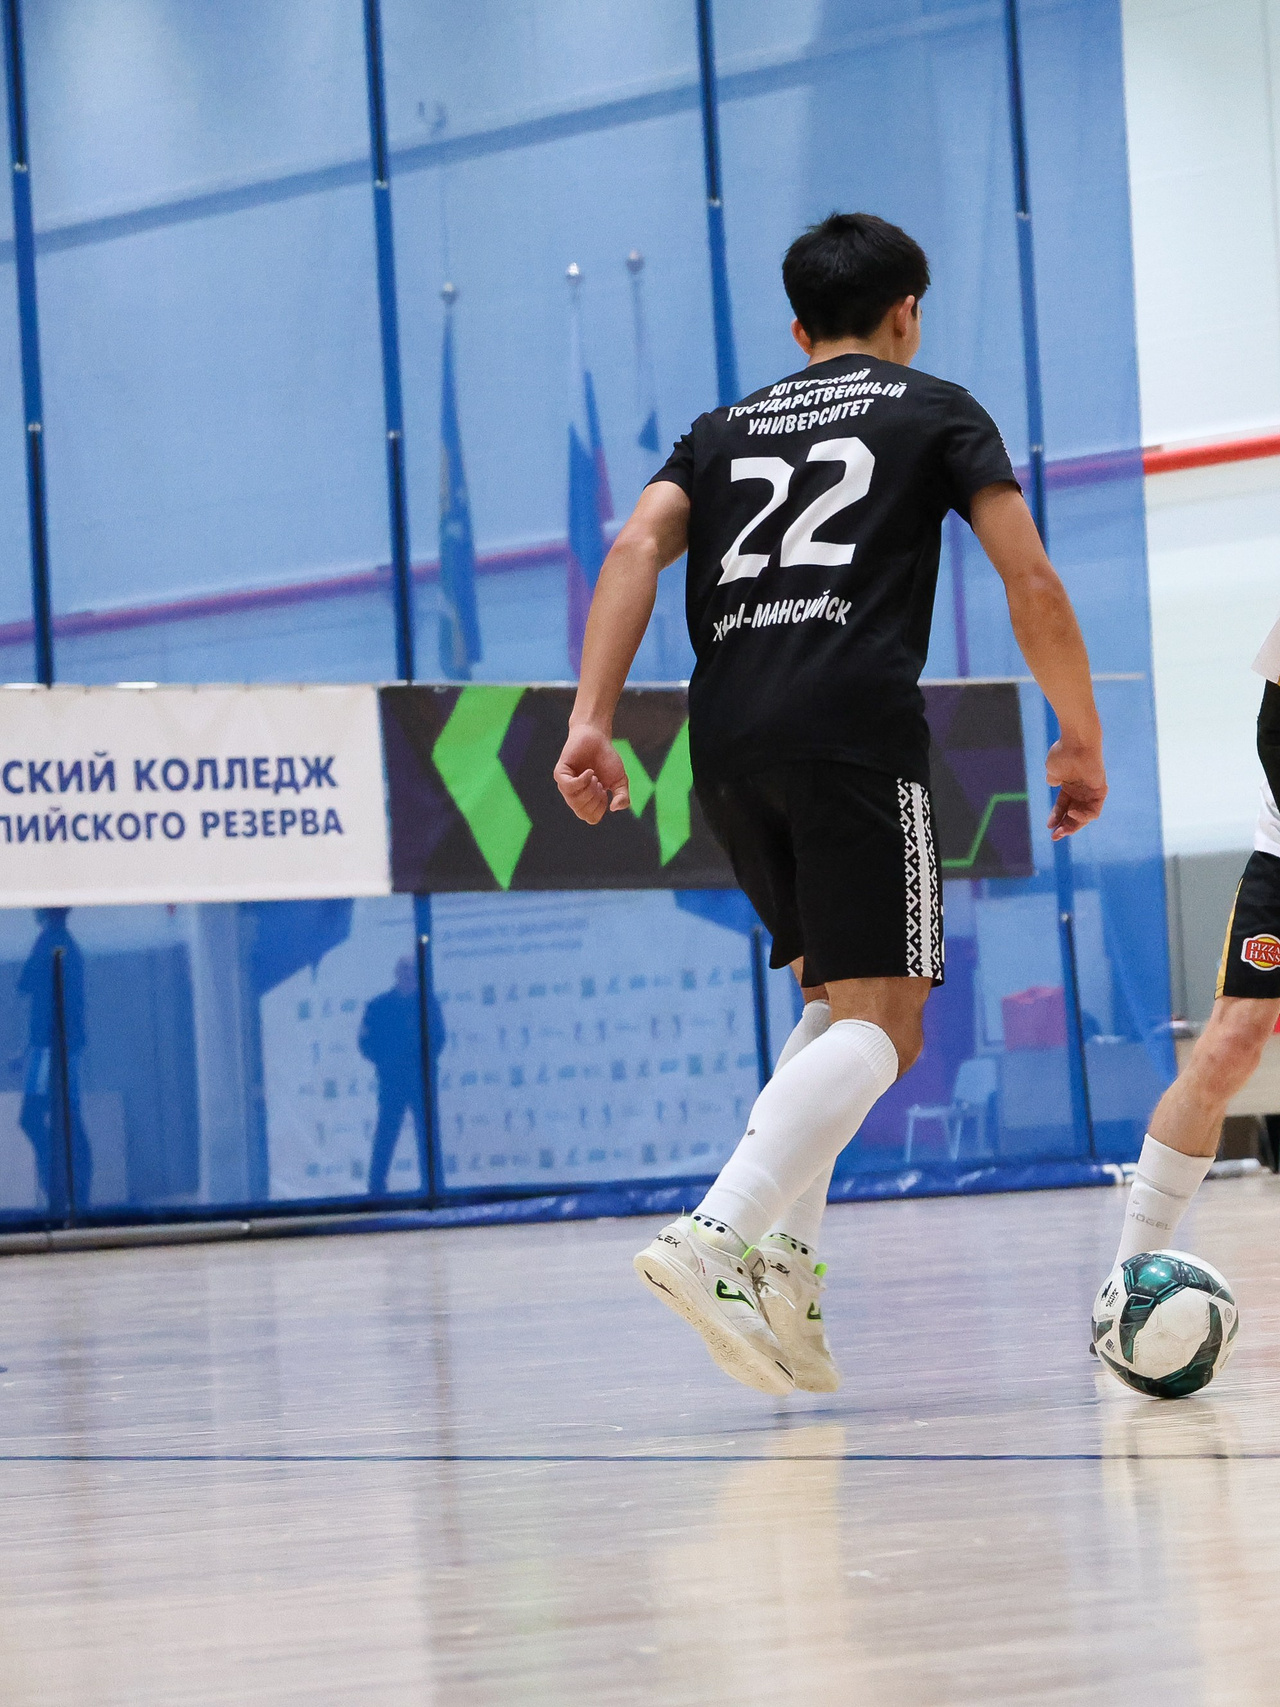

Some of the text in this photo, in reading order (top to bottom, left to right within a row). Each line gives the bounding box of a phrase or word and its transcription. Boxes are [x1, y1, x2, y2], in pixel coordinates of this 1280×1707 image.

[727, 382, 907, 421] ГОСУДАРСТВЕННЫЙ
[747, 399, 874, 435] УНИВЕРСИТЕТ
[717, 437, 875, 585] 22
[1, 751, 338, 795] СКИЙ КОЛЛЕДЖ
[201, 808, 344, 840] РЕЗЕРВА
[1249, 950, 1280, 963] HANS
[1250, 942, 1280, 954] PIZZA
